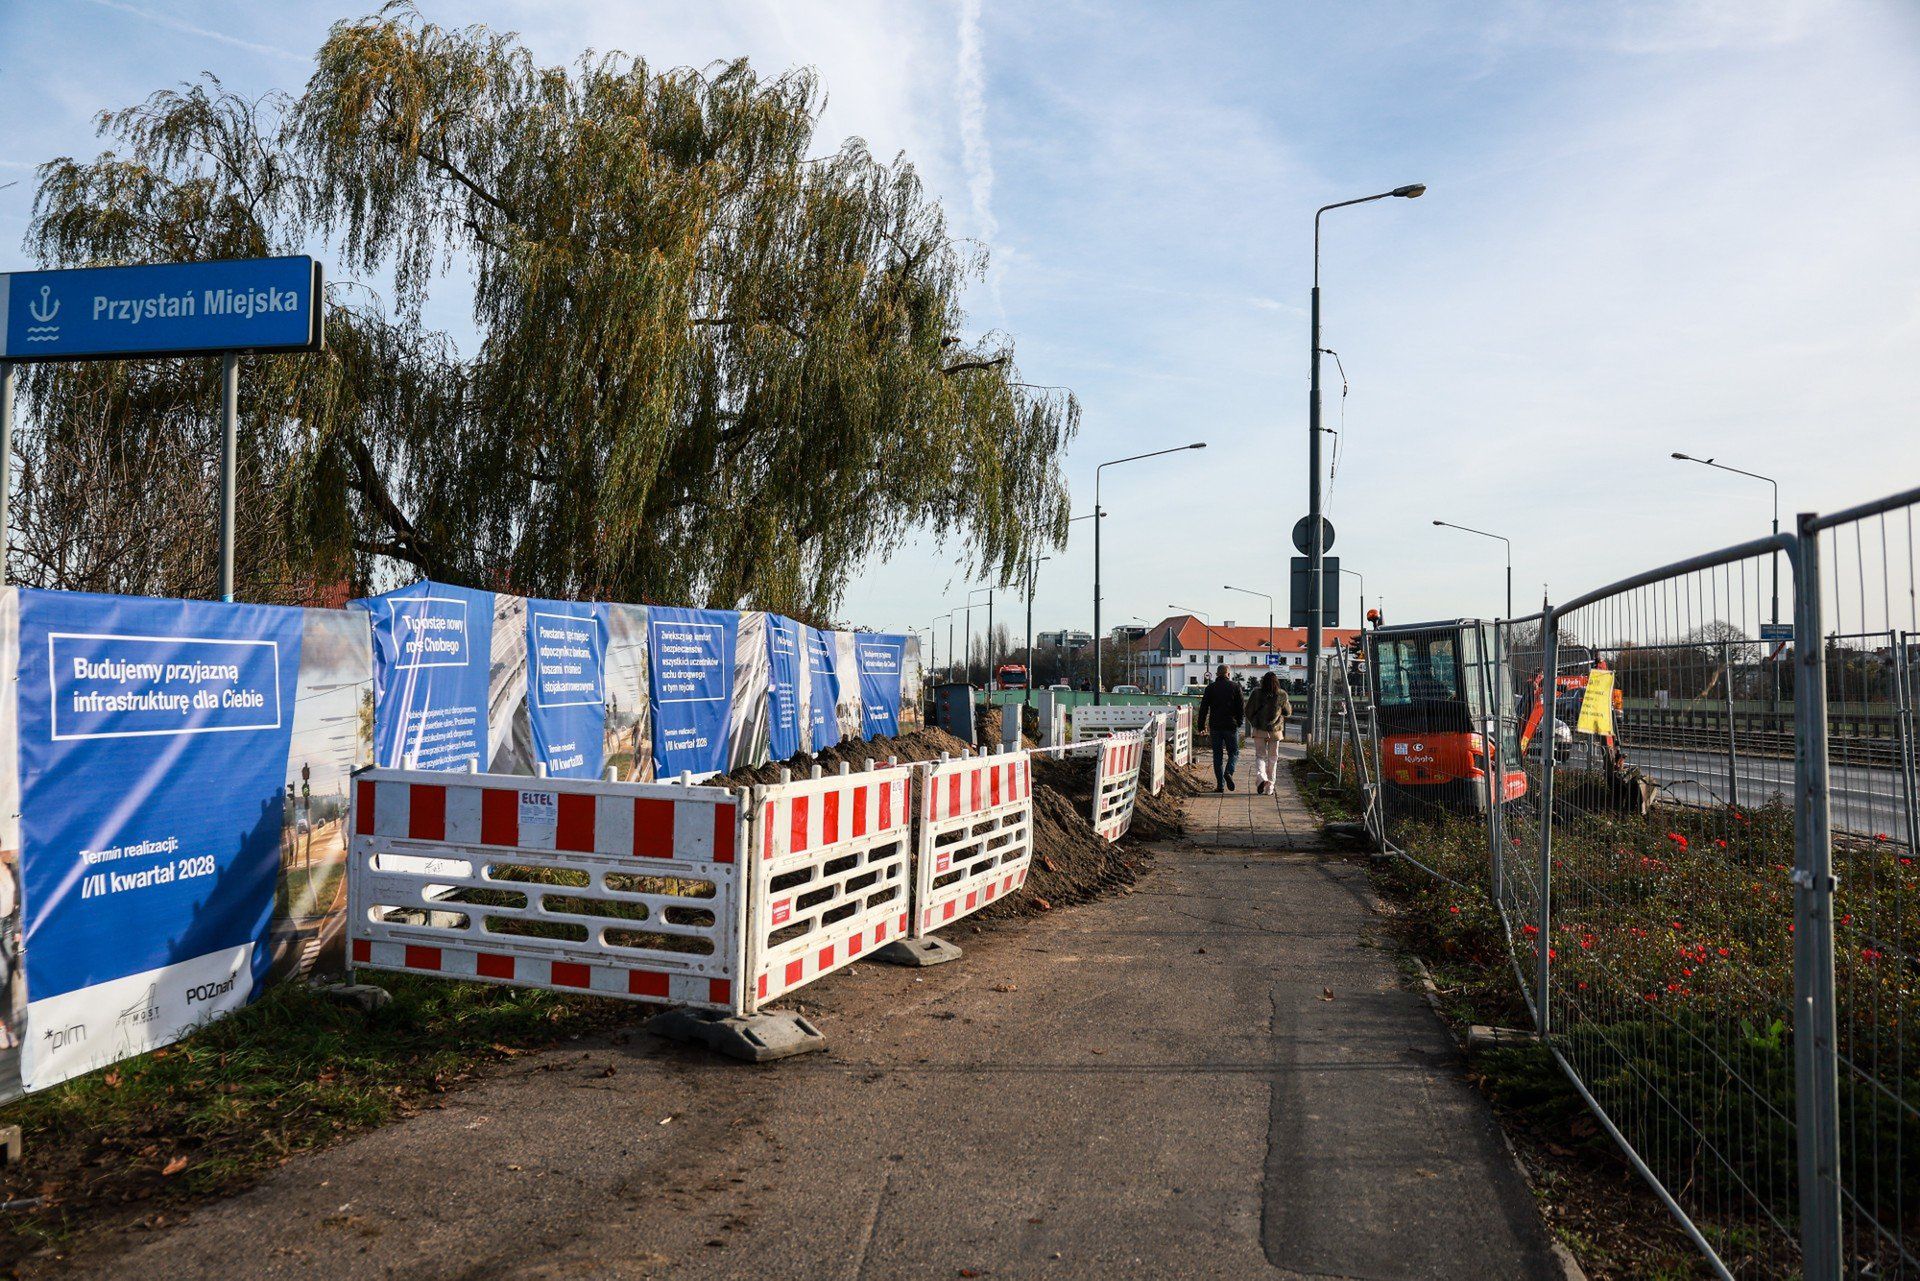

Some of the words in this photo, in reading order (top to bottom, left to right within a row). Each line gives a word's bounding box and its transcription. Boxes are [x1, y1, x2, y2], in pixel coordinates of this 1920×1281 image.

[93, 291, 195, 324] Przystań
[204, 286, 298, 319] Miejska
[73, 657, 163, 684] Budujemy
[165, 661, 238, 685] przyjazną
[73, 689, 190, 715] infrastrukturę
[192, 689, 219, 709] dla
[222, 688, 264, 708] Ciebie
[521, 792, 554, 806] ELTEL
[79, 846, 122, 866] Termin
[124, 836, 179, 858] realizacji:
[81, 873, 107, 899] I/II
[110, 861, 175, 894] kwartał
[178, 854, 216, 880] 2028
